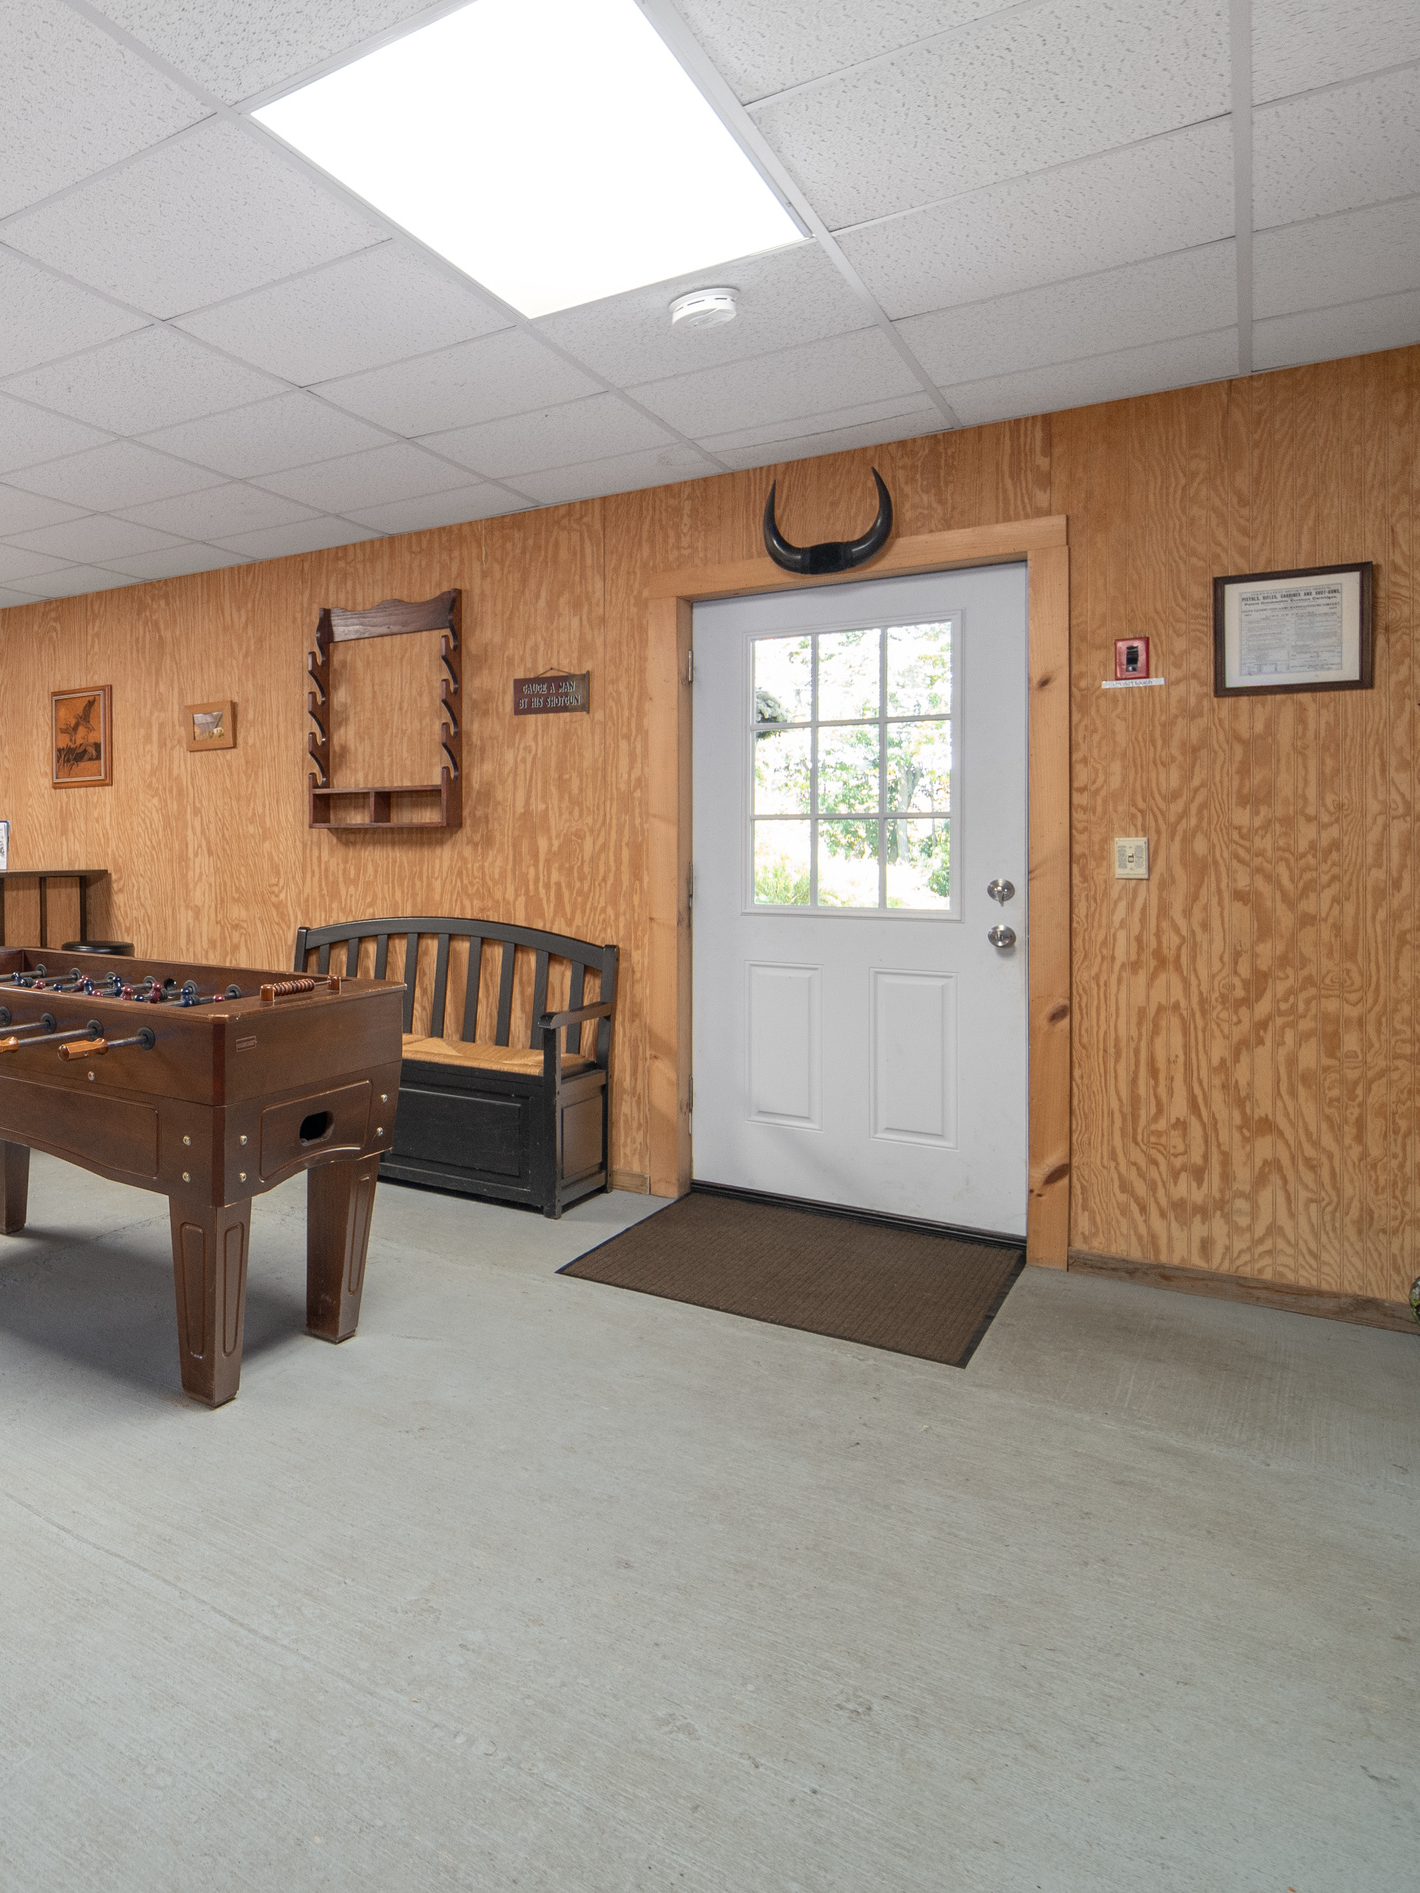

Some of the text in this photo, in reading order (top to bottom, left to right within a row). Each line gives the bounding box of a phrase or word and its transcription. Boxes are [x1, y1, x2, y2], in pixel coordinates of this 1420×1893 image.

[549, 682, 556, 694] A
[558, 681, 576, 693] MAN
[519, 694, 581, 709] BY HIS SHOTGUN
